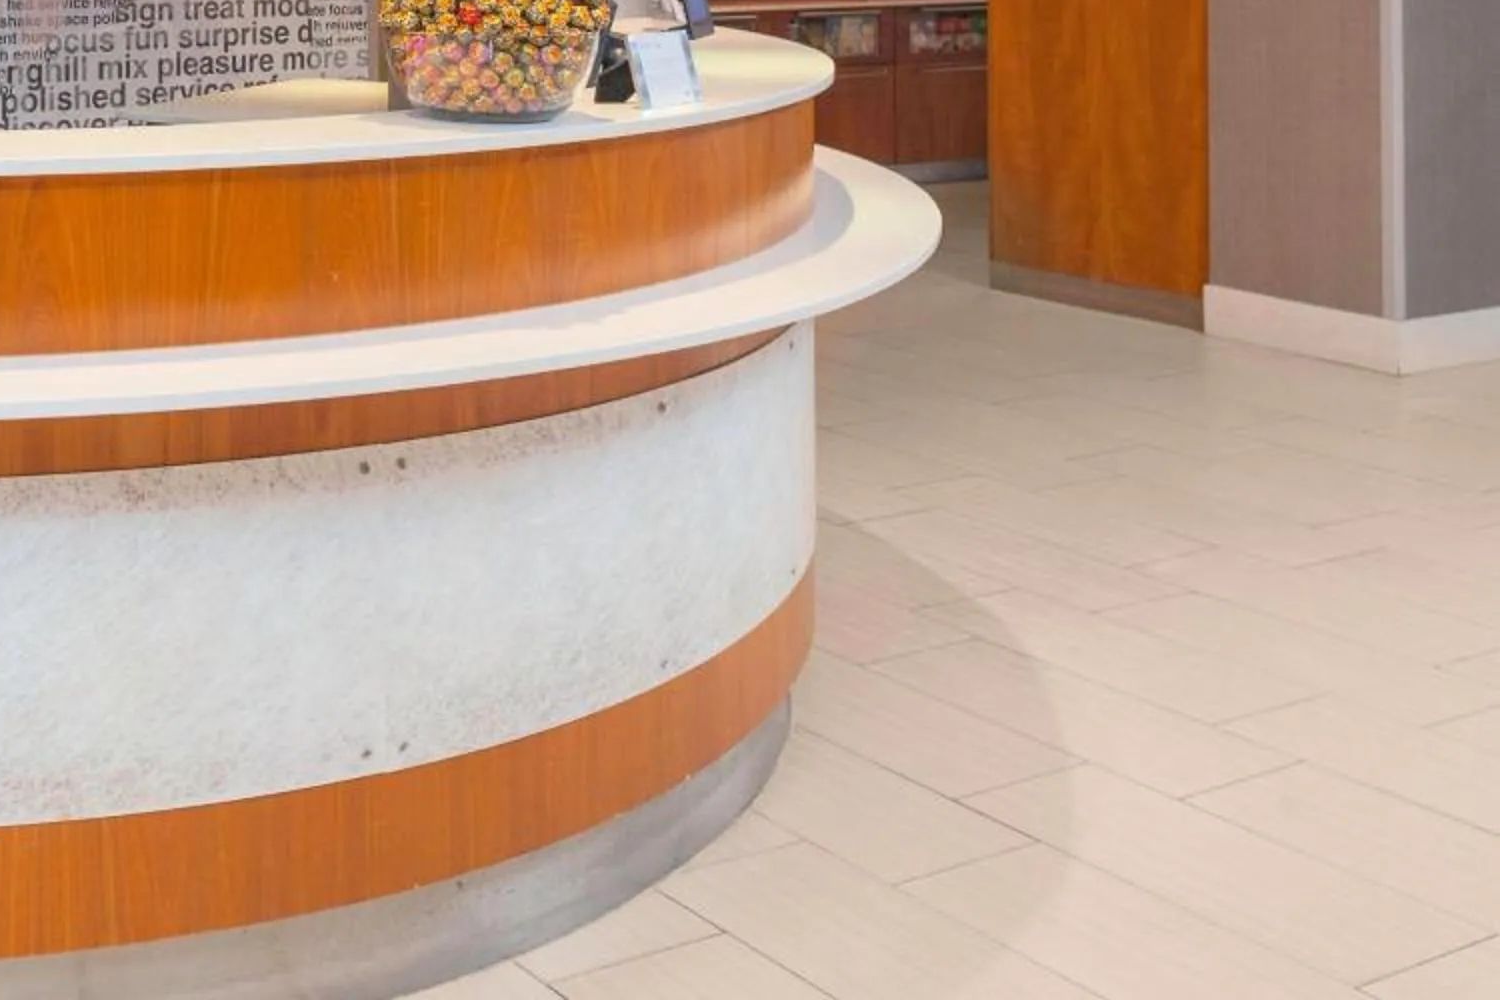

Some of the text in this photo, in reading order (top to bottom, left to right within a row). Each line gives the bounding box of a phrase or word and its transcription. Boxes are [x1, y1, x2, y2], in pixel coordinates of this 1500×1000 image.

[124, 24, 169, 50] fun
[178, 20, 291, 51] surprise
[98, 52, 148, 81] mix
[158, 51, 274, 83] pleasure
[283, 48, 348, 72] more
[1, 81, 127, 122] polished
